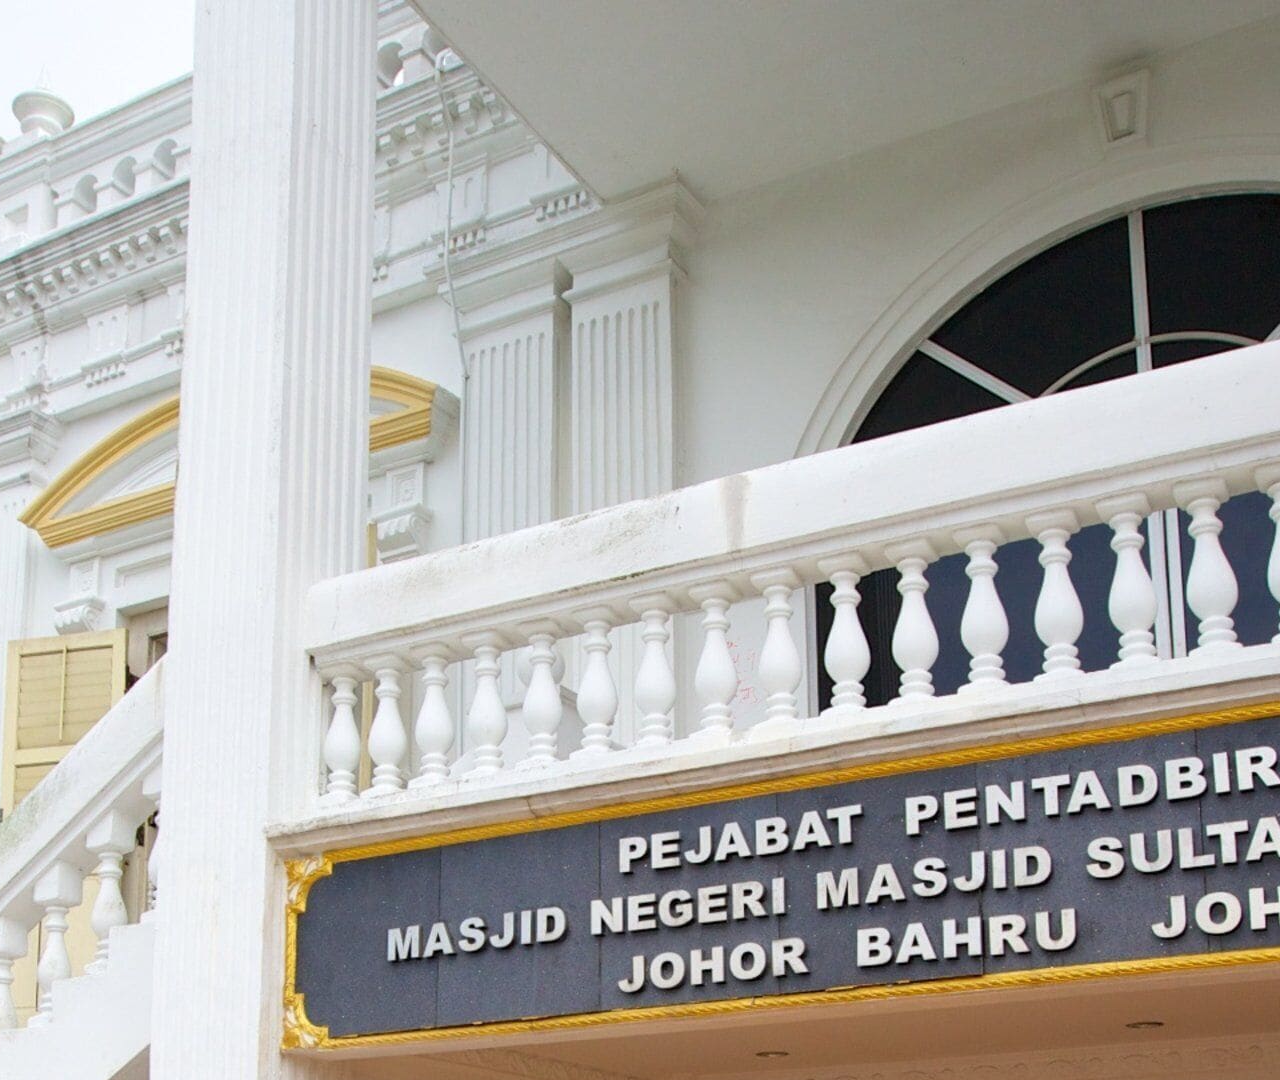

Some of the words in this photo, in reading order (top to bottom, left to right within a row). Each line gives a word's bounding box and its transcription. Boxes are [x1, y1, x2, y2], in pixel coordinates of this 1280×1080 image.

[618, 803, 862, 873] PEJABAT
[387, 906, 566, 962] MASJID
[590, 876, 785, 936] NEGERI
[816, 845, 1052, 910] MASJID
[617, 936, 809, 993] JOHOR
[856, 907, 1076, 967] BAHRU
